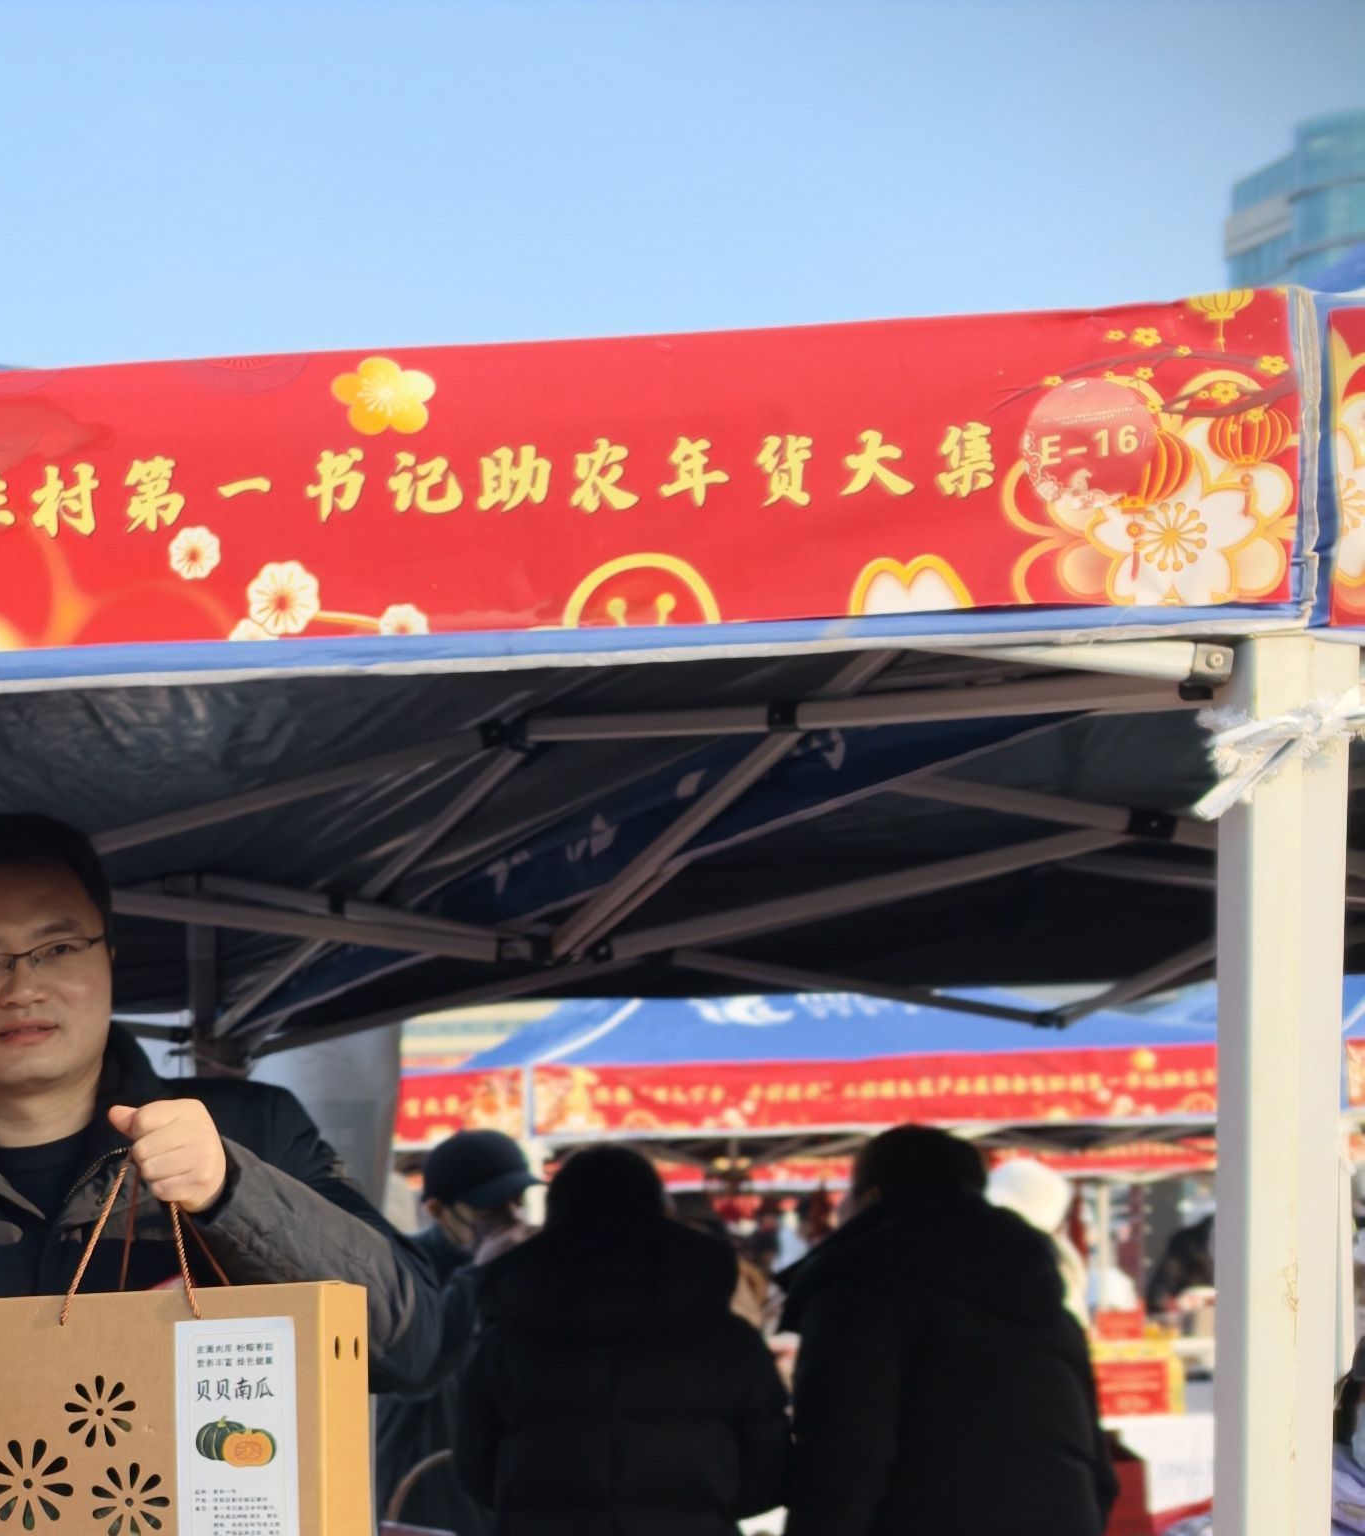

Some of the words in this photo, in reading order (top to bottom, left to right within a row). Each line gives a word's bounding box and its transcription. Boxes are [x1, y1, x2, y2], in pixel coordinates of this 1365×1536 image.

[1040, 424, 1140, 467] E-16
[195, 1376, 274, 1402] 贝贝南瓜
